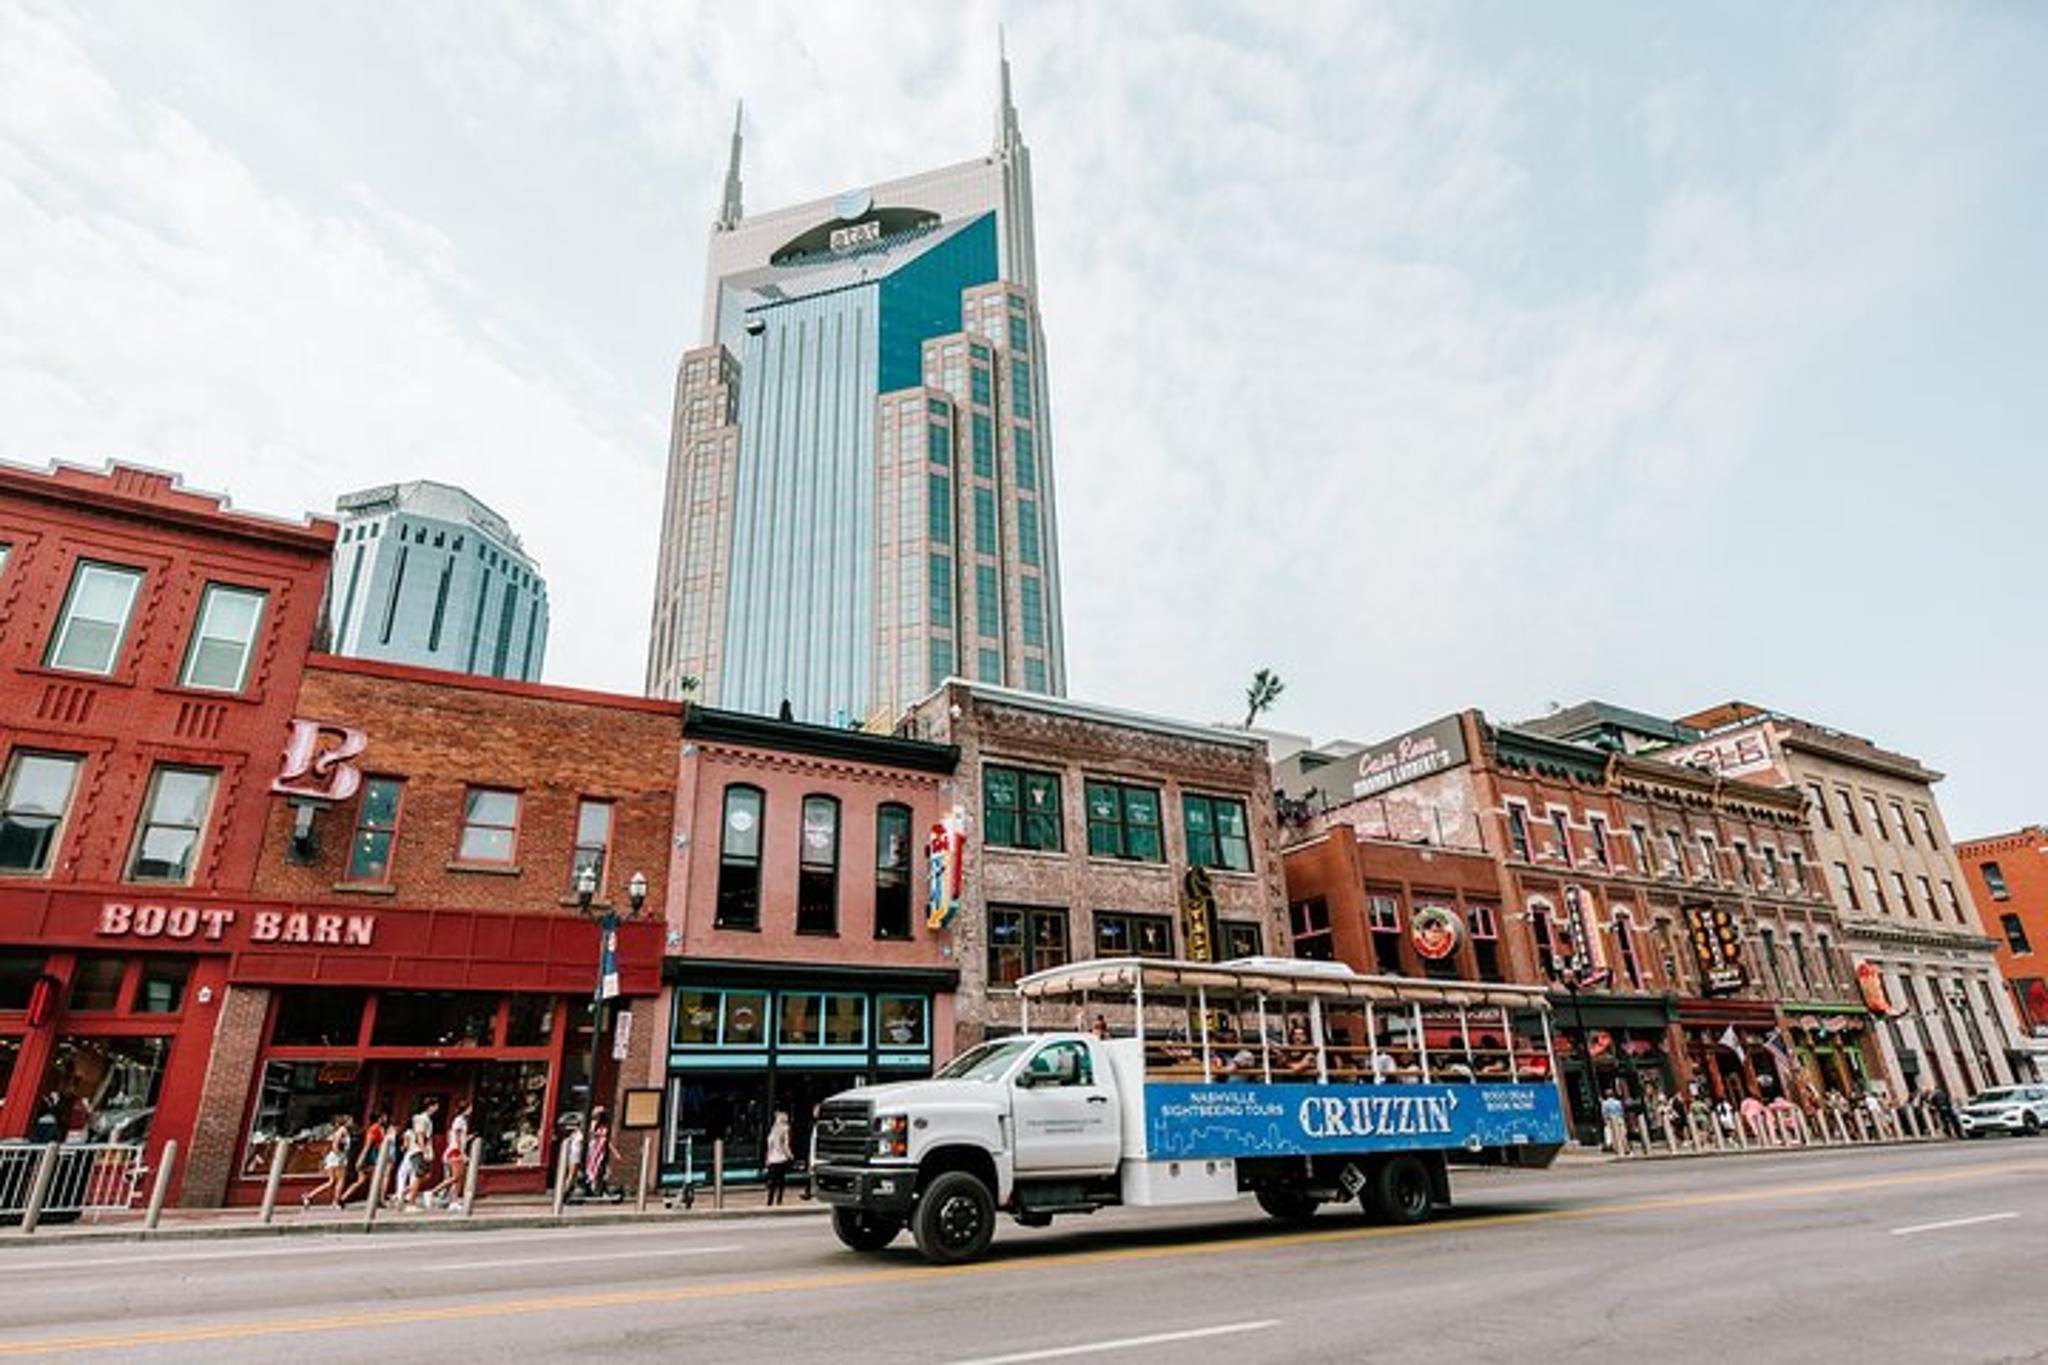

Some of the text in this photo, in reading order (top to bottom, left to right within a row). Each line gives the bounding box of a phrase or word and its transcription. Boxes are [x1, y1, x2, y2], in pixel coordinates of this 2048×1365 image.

[270, 718, 367, 800] B
[98, 903, 374, 945] BOOT BARN
[1161, 1103, 1284, 1117] SIGHTSEEING TOURS
[1191, 1091, 1256, 1104] NASHVILLE
[1299, 1088, 1458, 1137] CRUZZIN'
